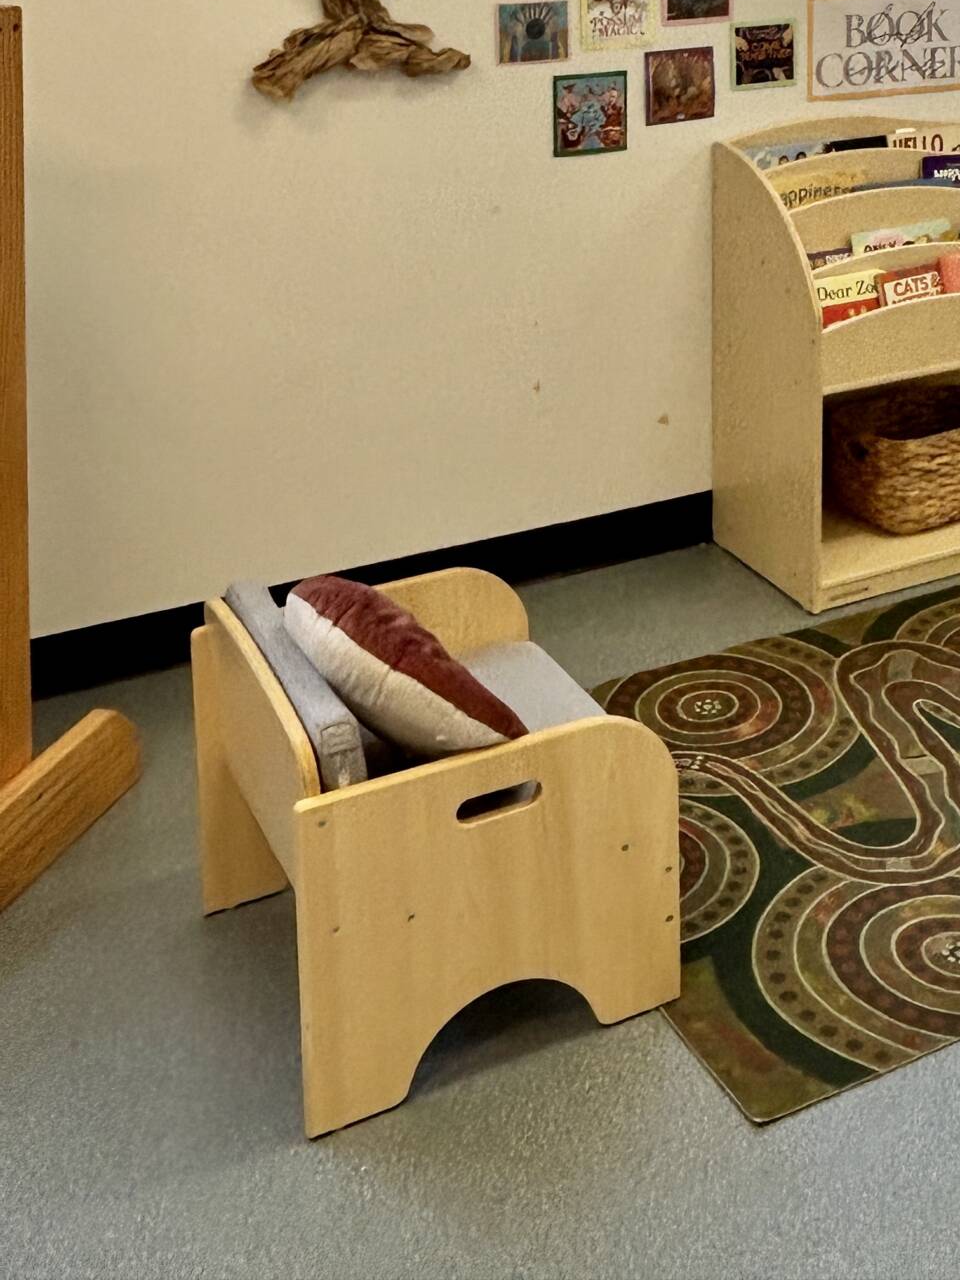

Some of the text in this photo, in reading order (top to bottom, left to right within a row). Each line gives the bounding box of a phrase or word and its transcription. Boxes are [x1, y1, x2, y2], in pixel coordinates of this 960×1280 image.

[845, 7, 950, 48] BOOK
[817, 286, 852, 301] Dear
[893, 276, 928, 297] CATS
